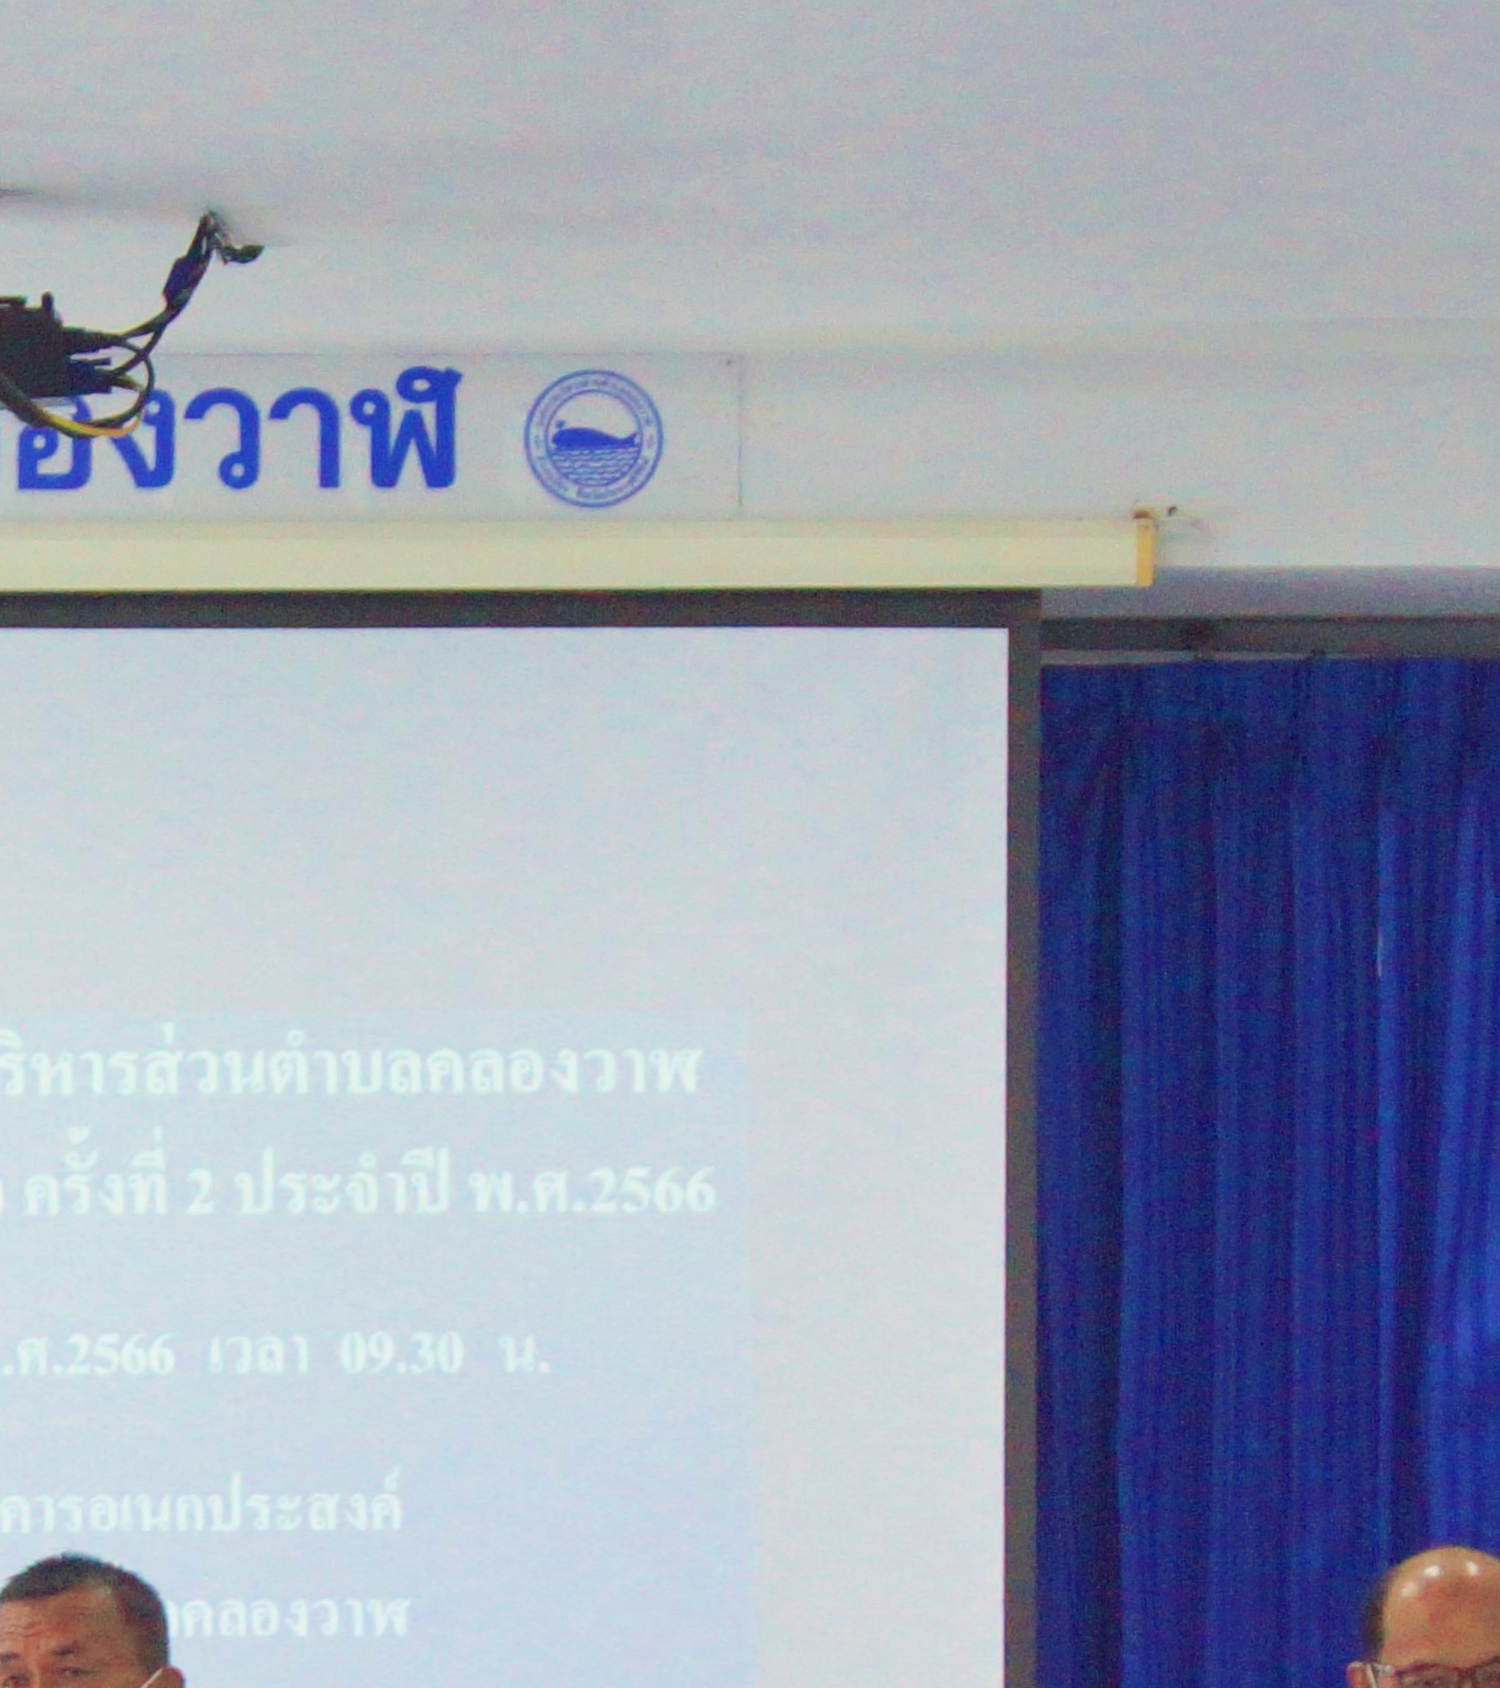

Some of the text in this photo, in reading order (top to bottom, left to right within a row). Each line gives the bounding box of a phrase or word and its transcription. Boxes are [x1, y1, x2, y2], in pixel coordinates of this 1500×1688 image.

[26, 1125, 167, 1216] ครั้งที่
[184, 1167, 216, 1216] 2
[233, 1145, 452, 1216] ประจำปี
[467, 1165, 718, 1215] พ.ศ.2566
[207, 1333, 310, 1378] เวลา
[338, 1330, 466, 1377] 09.30
[496, 1332, 553, 1376] น.
